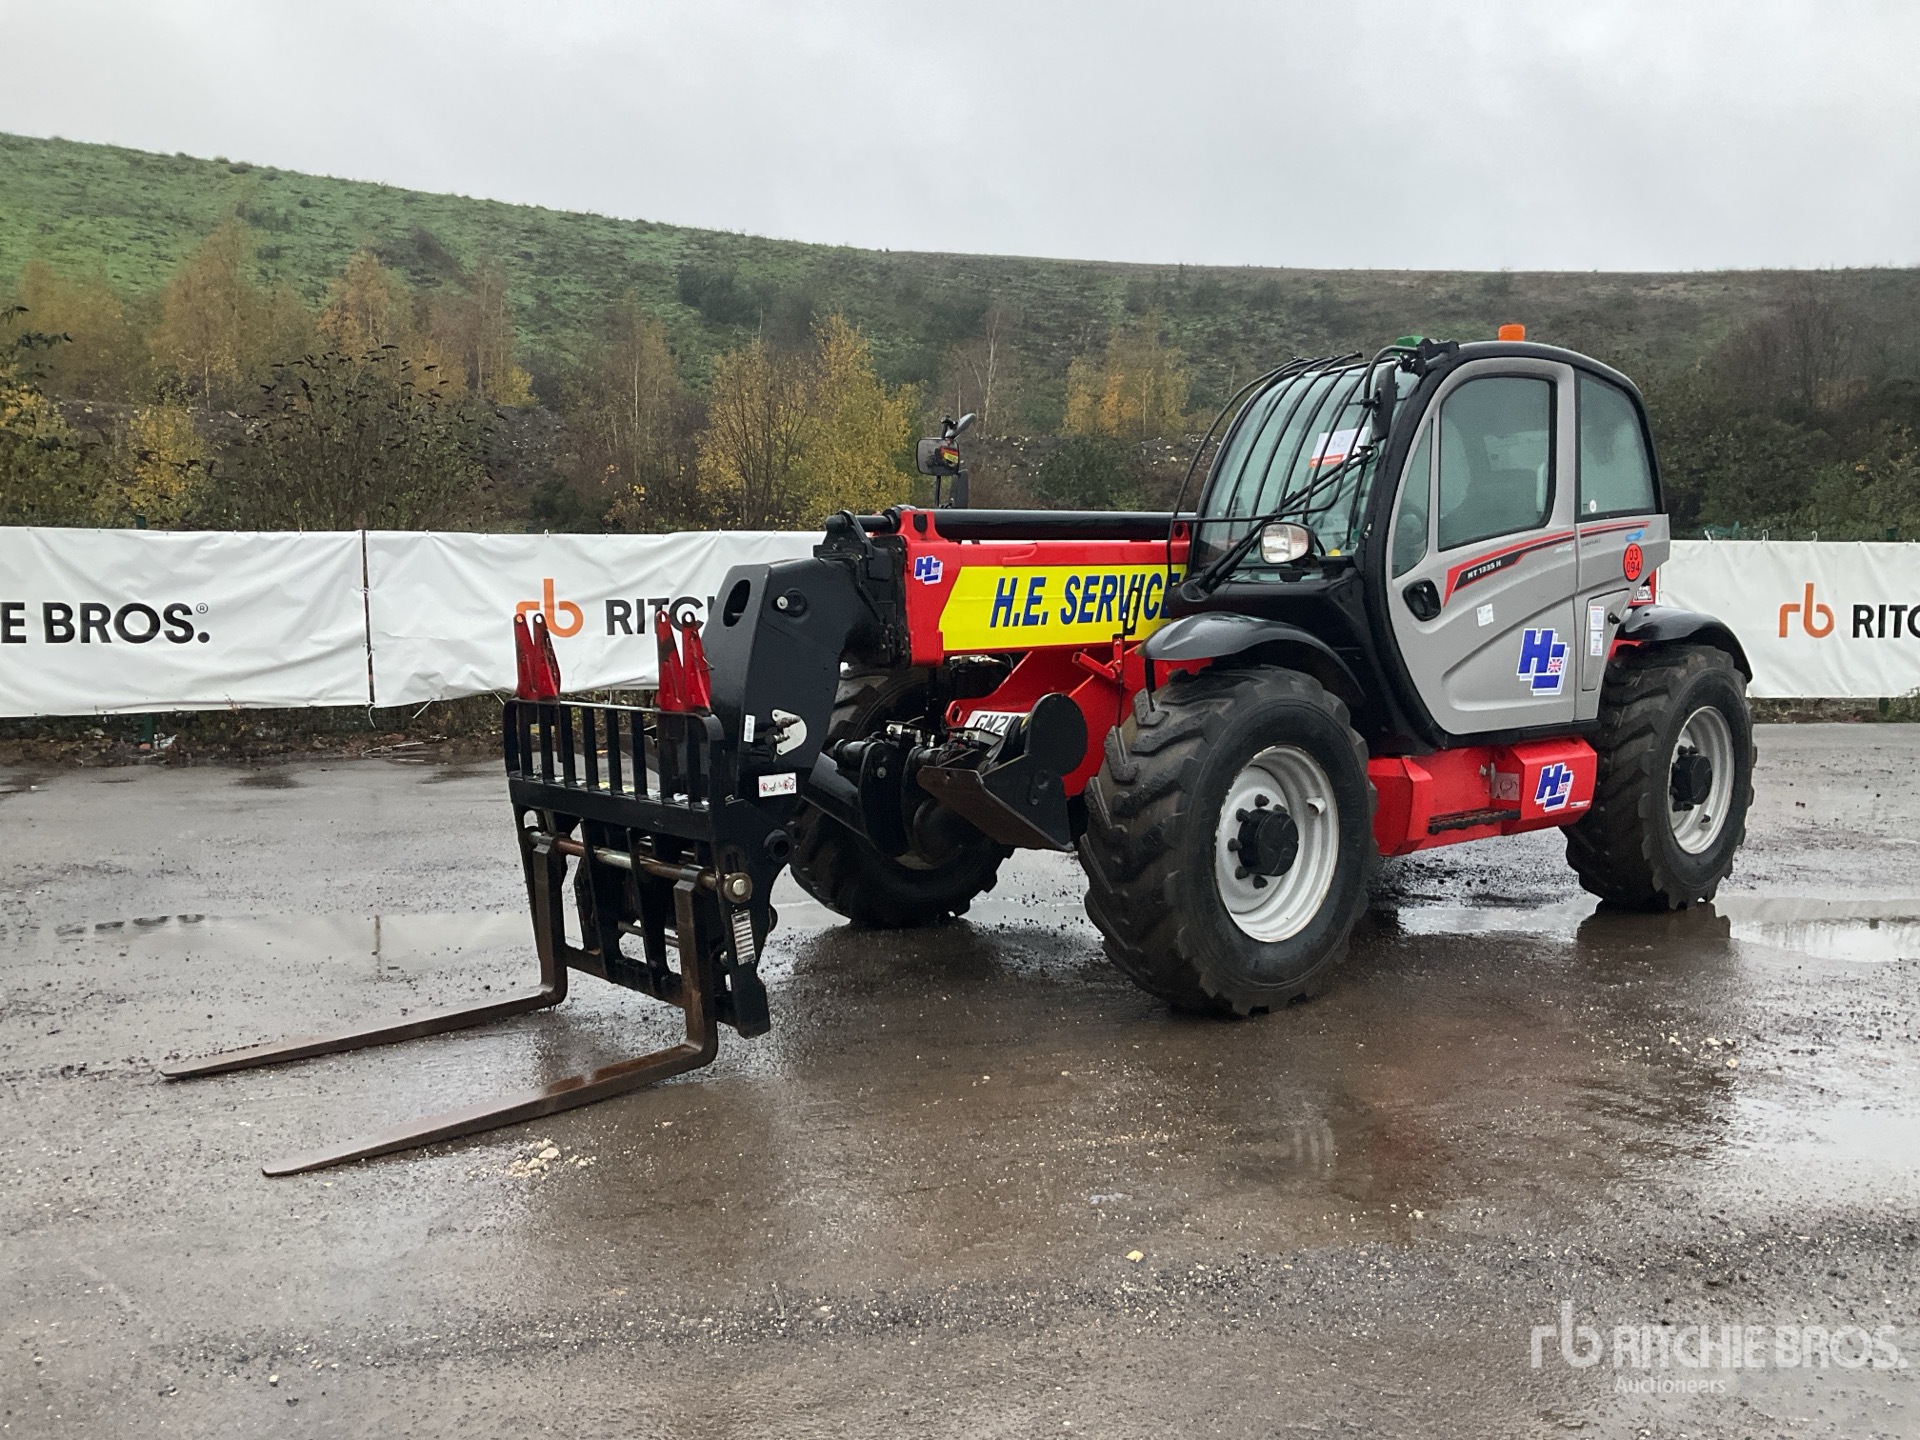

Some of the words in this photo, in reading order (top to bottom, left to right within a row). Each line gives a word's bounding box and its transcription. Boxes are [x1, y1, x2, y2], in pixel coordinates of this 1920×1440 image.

[1626, 561, 1640, 573] 094
[1628, 548, 1639, 560] 03
[515, 578, 584, 638] rb
[989, 576, 1049, 629] H.E.
[1778, 582, 1835, 638] rb
